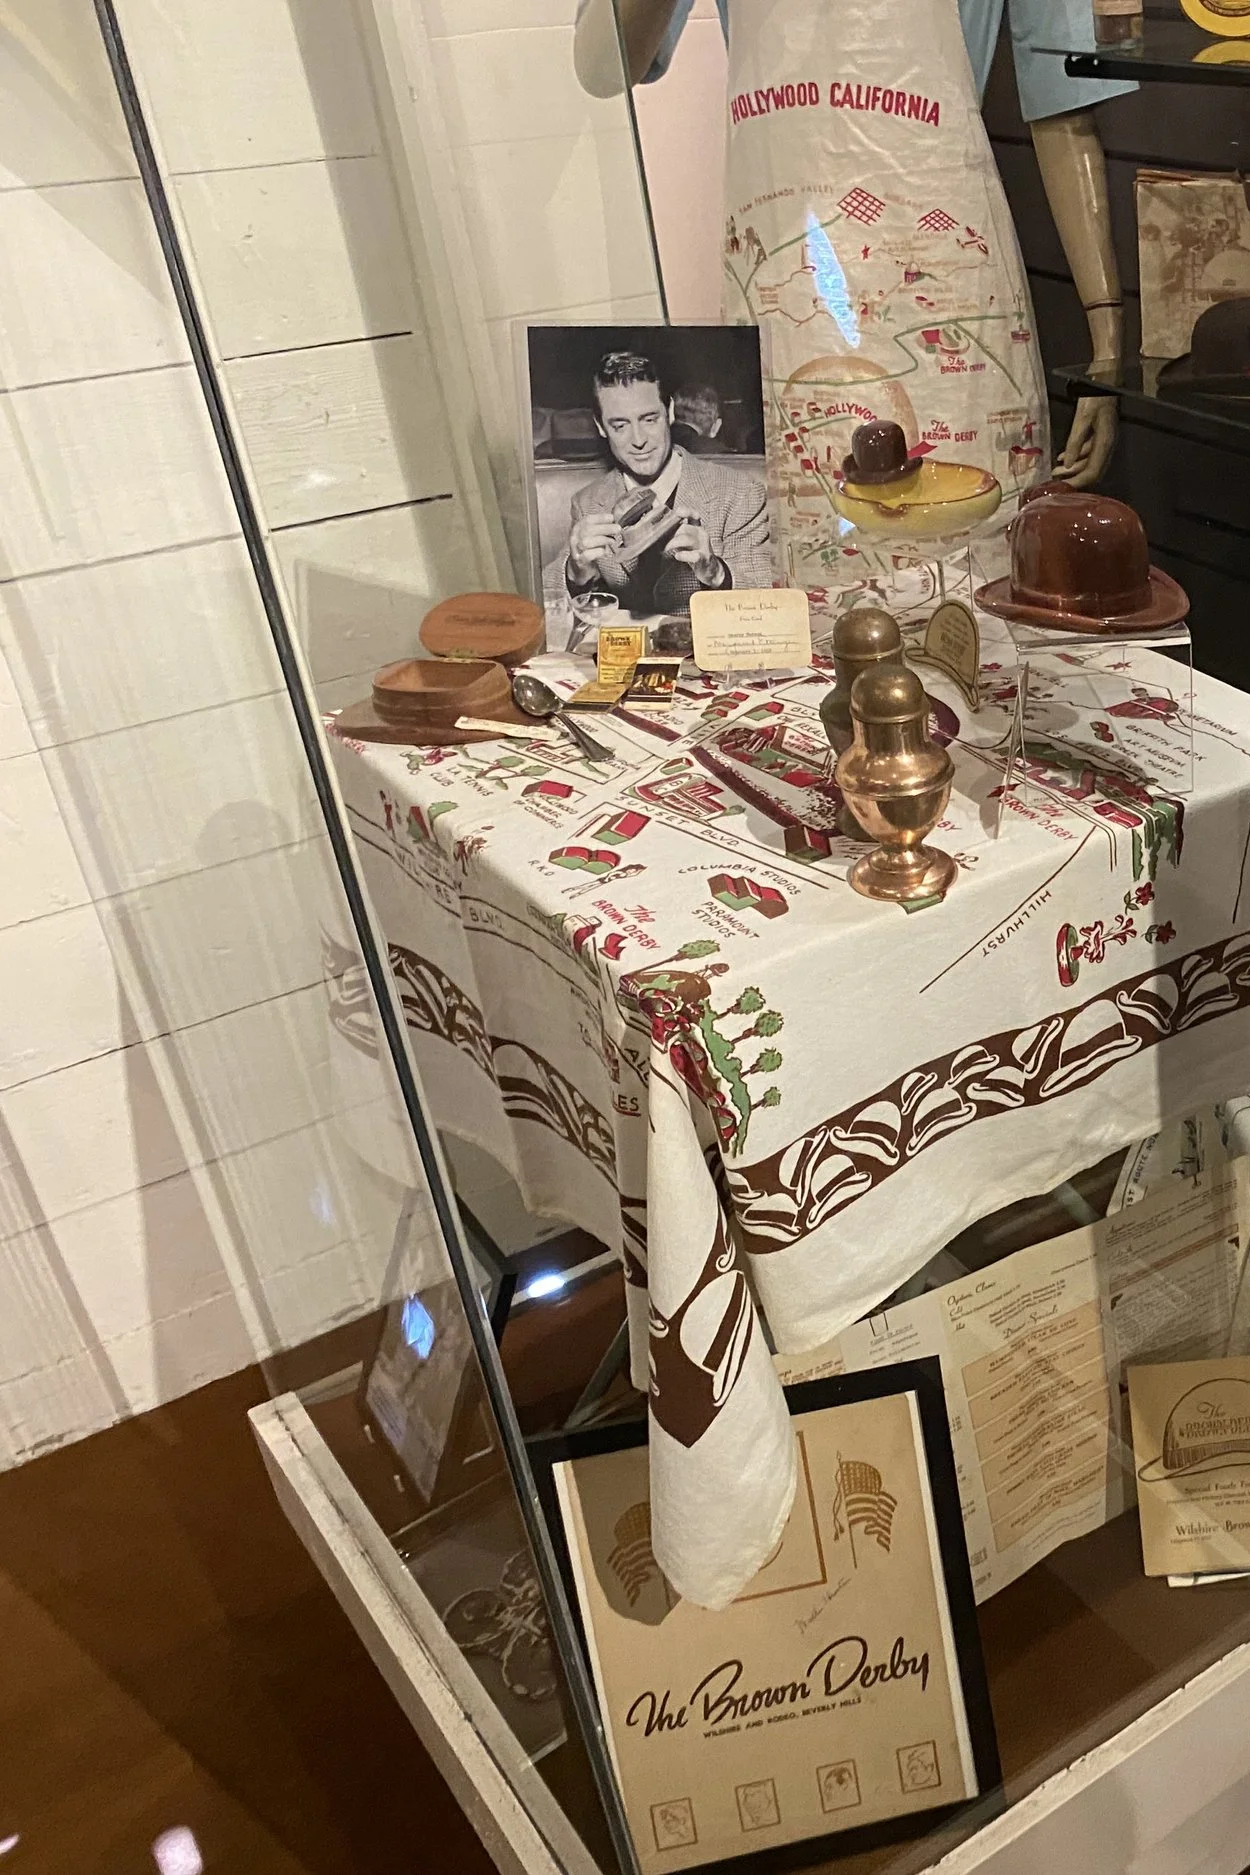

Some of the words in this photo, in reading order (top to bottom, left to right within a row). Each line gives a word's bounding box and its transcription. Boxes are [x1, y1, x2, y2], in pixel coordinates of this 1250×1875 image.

[731, 82, 820, 125] HOLLYWOOD
[829, 81, 941, 127] CALIFORNIA
[940, 364, 968, 374] BROWN
[947, 356, 966, 366] The
[824, 402, 877, 422] HOLLYWOO
[930, 419, 950, 432] The
[921, 431, 951, 441] BROWN
[955, 430, 978, 442] DERBY
[790, 706, 819, 718] BLV
[1174, 745, 1208, 762] PARK
[430, 771, 455, 788] CLUB
[462, 775, 495, 798] TENNIS
[614, 795, 690, 826] SUNSET
[1038, 817, 1080, 842] DERBY
[677, 863, 754, 874] COLUMBIA
[760, 870, 802, 896] STUDIOS
[624, 904, 657, 924] The
[690, 908, 736, 939] STUDIOS
[701, 900, 760, 940] PARAMOUNT
[591, 899, 628, 926] BROWN
[622, 922, 661, 950] DERBY
[1196, 1401, 1227, 1420] The
[1175, 1520, 1218, 1536] Wilshire
[626, 1689, 688, 1738] The
[689, 1658, 811, 1727] Brown
[806, 1635, 930, 1692] Derby
[703, 1723, 742, 1739] WILSHIRE
[745, 1718, 764, 1731] AND
[801, 1703, 837, 1717] BEVERLY
[839, 1696, 862, 1709] HILLS
